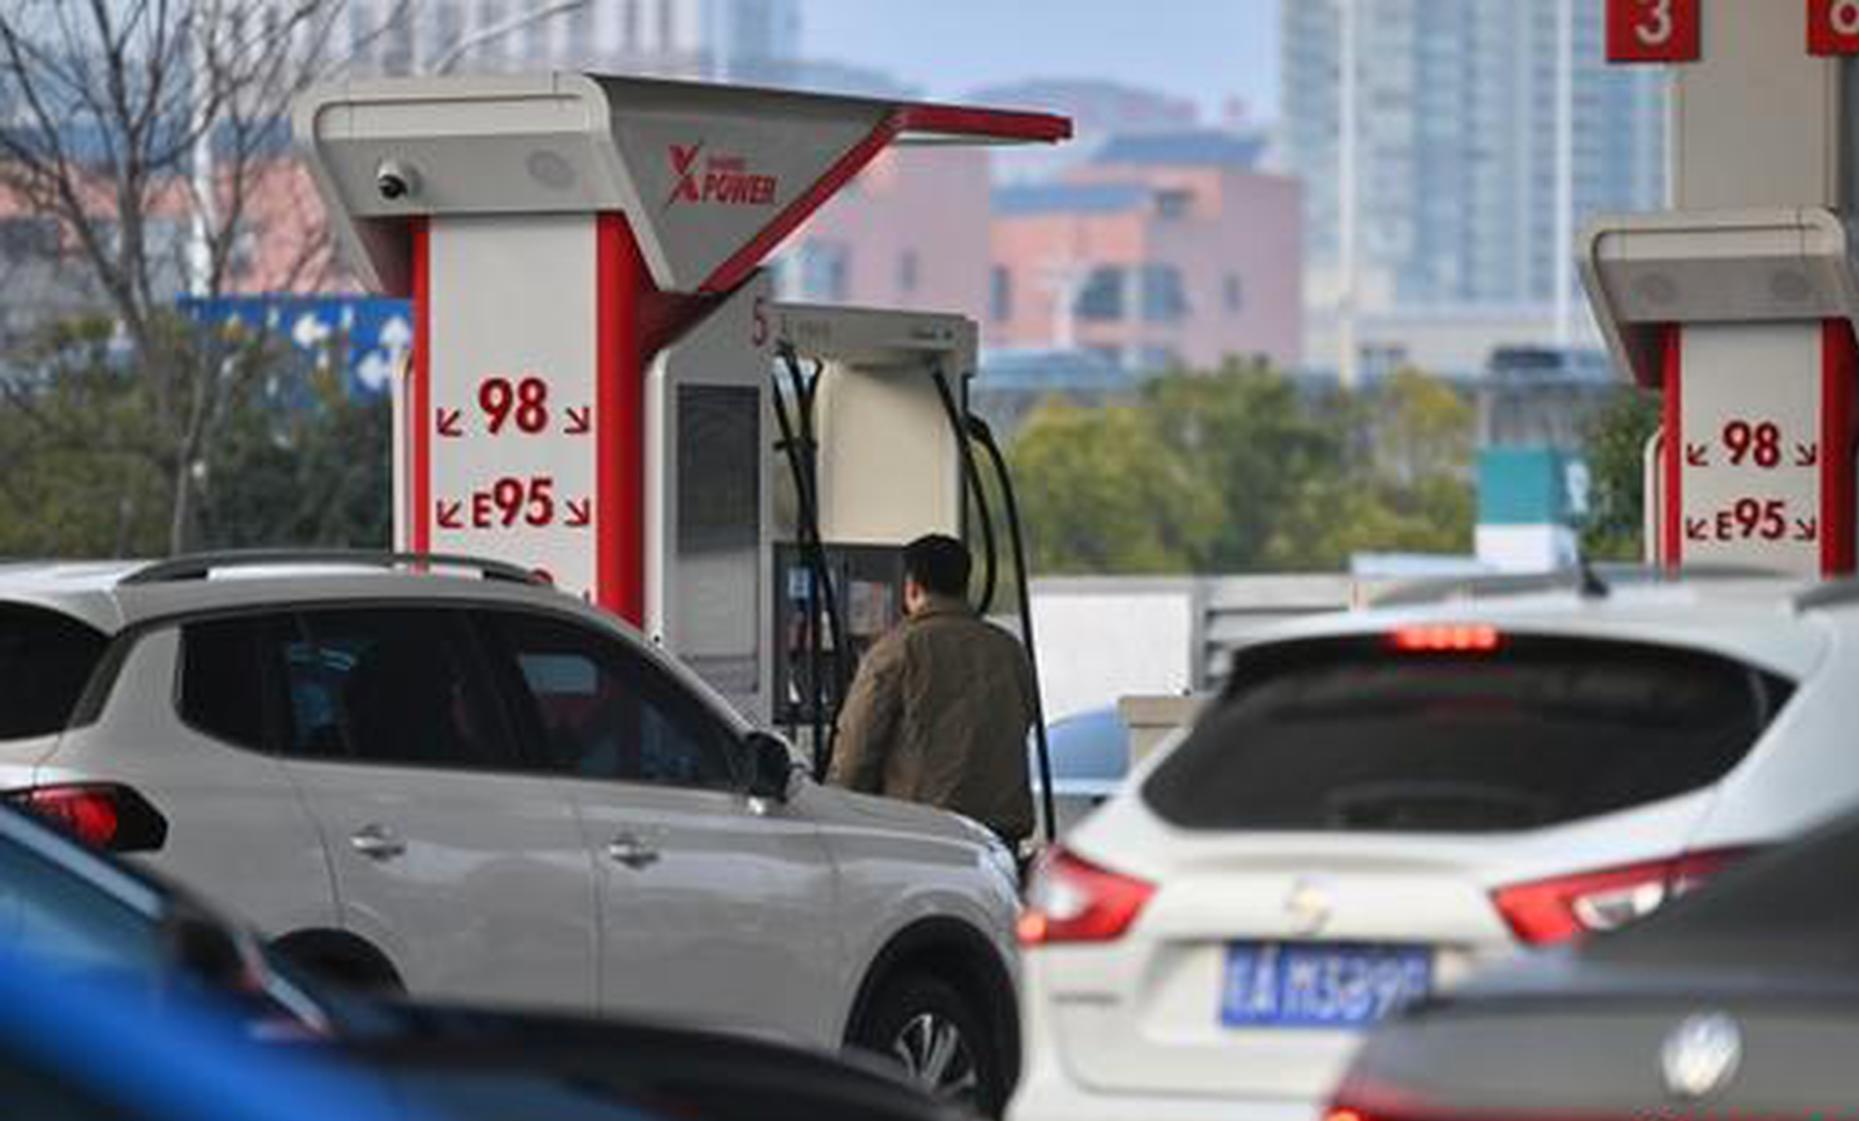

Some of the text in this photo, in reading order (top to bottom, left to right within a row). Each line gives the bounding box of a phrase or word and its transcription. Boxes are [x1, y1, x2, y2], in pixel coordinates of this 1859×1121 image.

[1635, 0, 1672, 44] 3
[702, 173, 776, 204] POWER
[753, 298, 768, 346] 5
[479, 377, 547, 434] 98
[1723, 420, 1781, 468] 98
[472, 477, 554, 528] E95
[1715, 498, 1787, 540] E95
